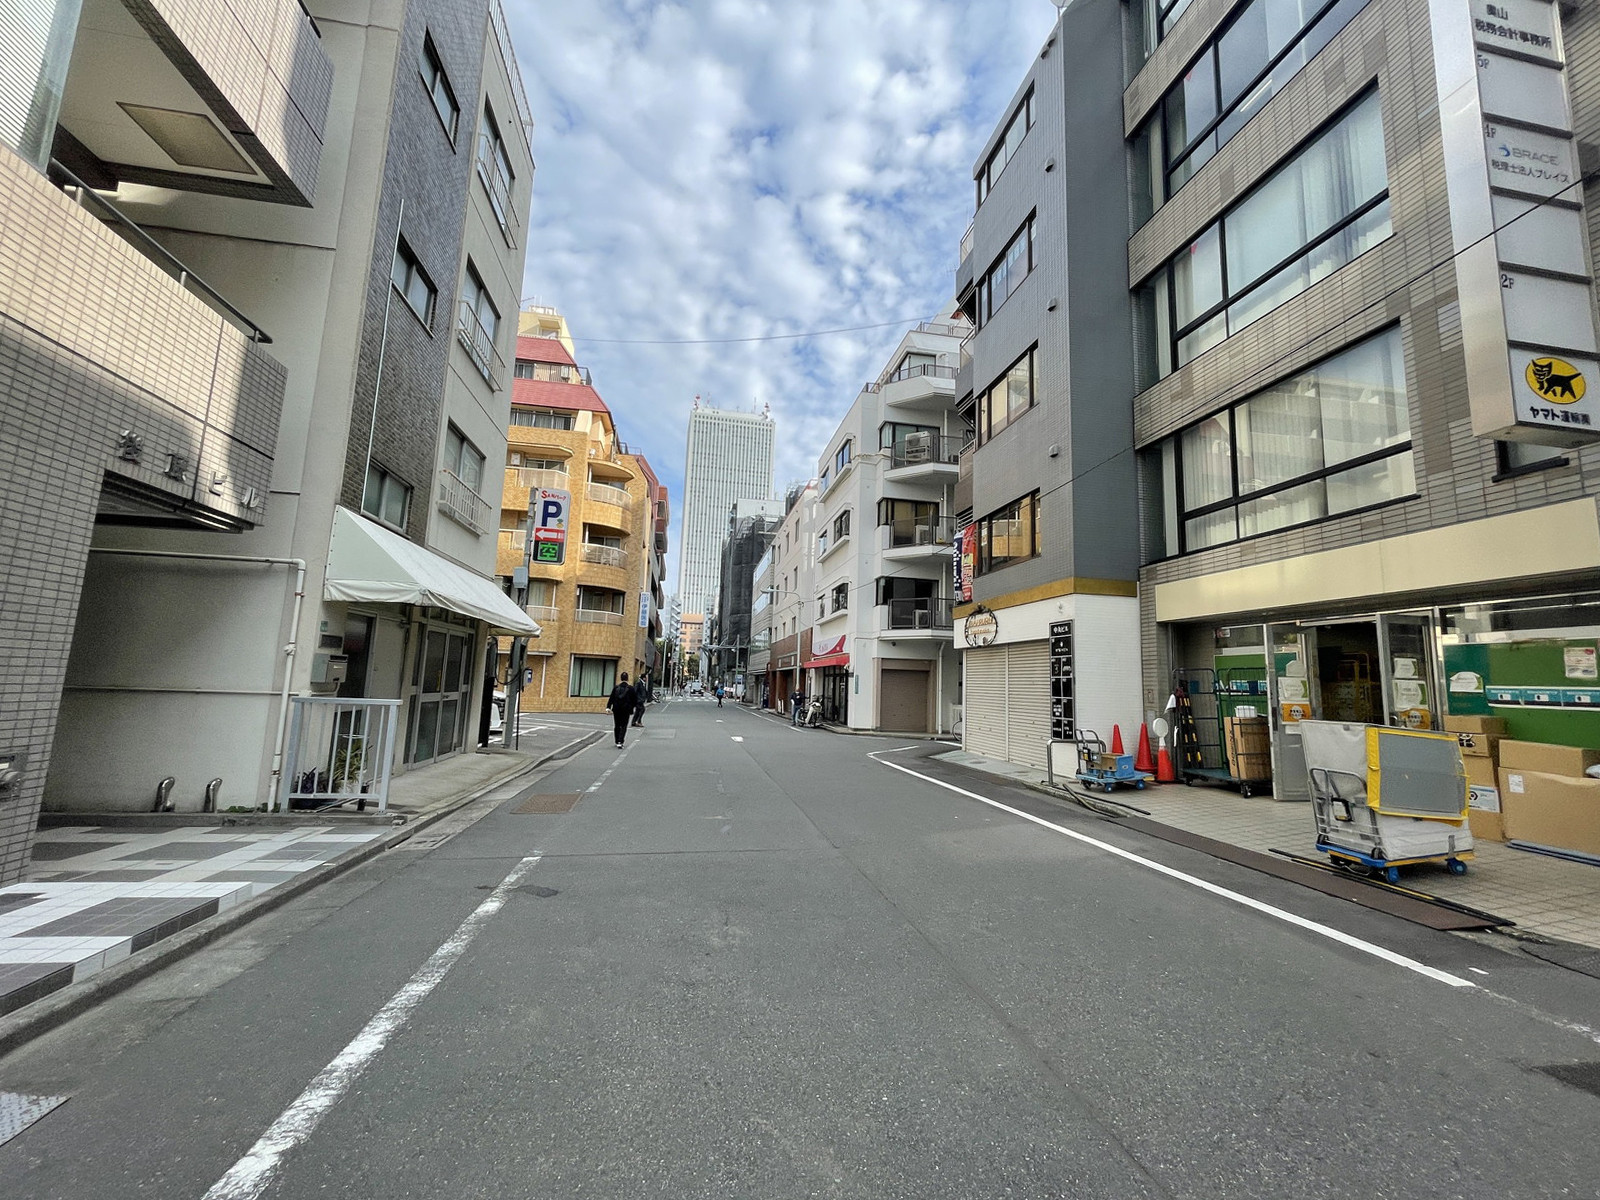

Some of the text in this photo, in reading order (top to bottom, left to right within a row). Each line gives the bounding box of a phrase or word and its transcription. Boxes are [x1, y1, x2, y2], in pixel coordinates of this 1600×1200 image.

[1475, 18, 1551, 49] 税務会計事務所
[1512, 147, 1558, 166] BRACE
[1501, 273, 1514, 289] 2F
[541, 500, 562, 527] P
[537, 542, 559, 561] 空
